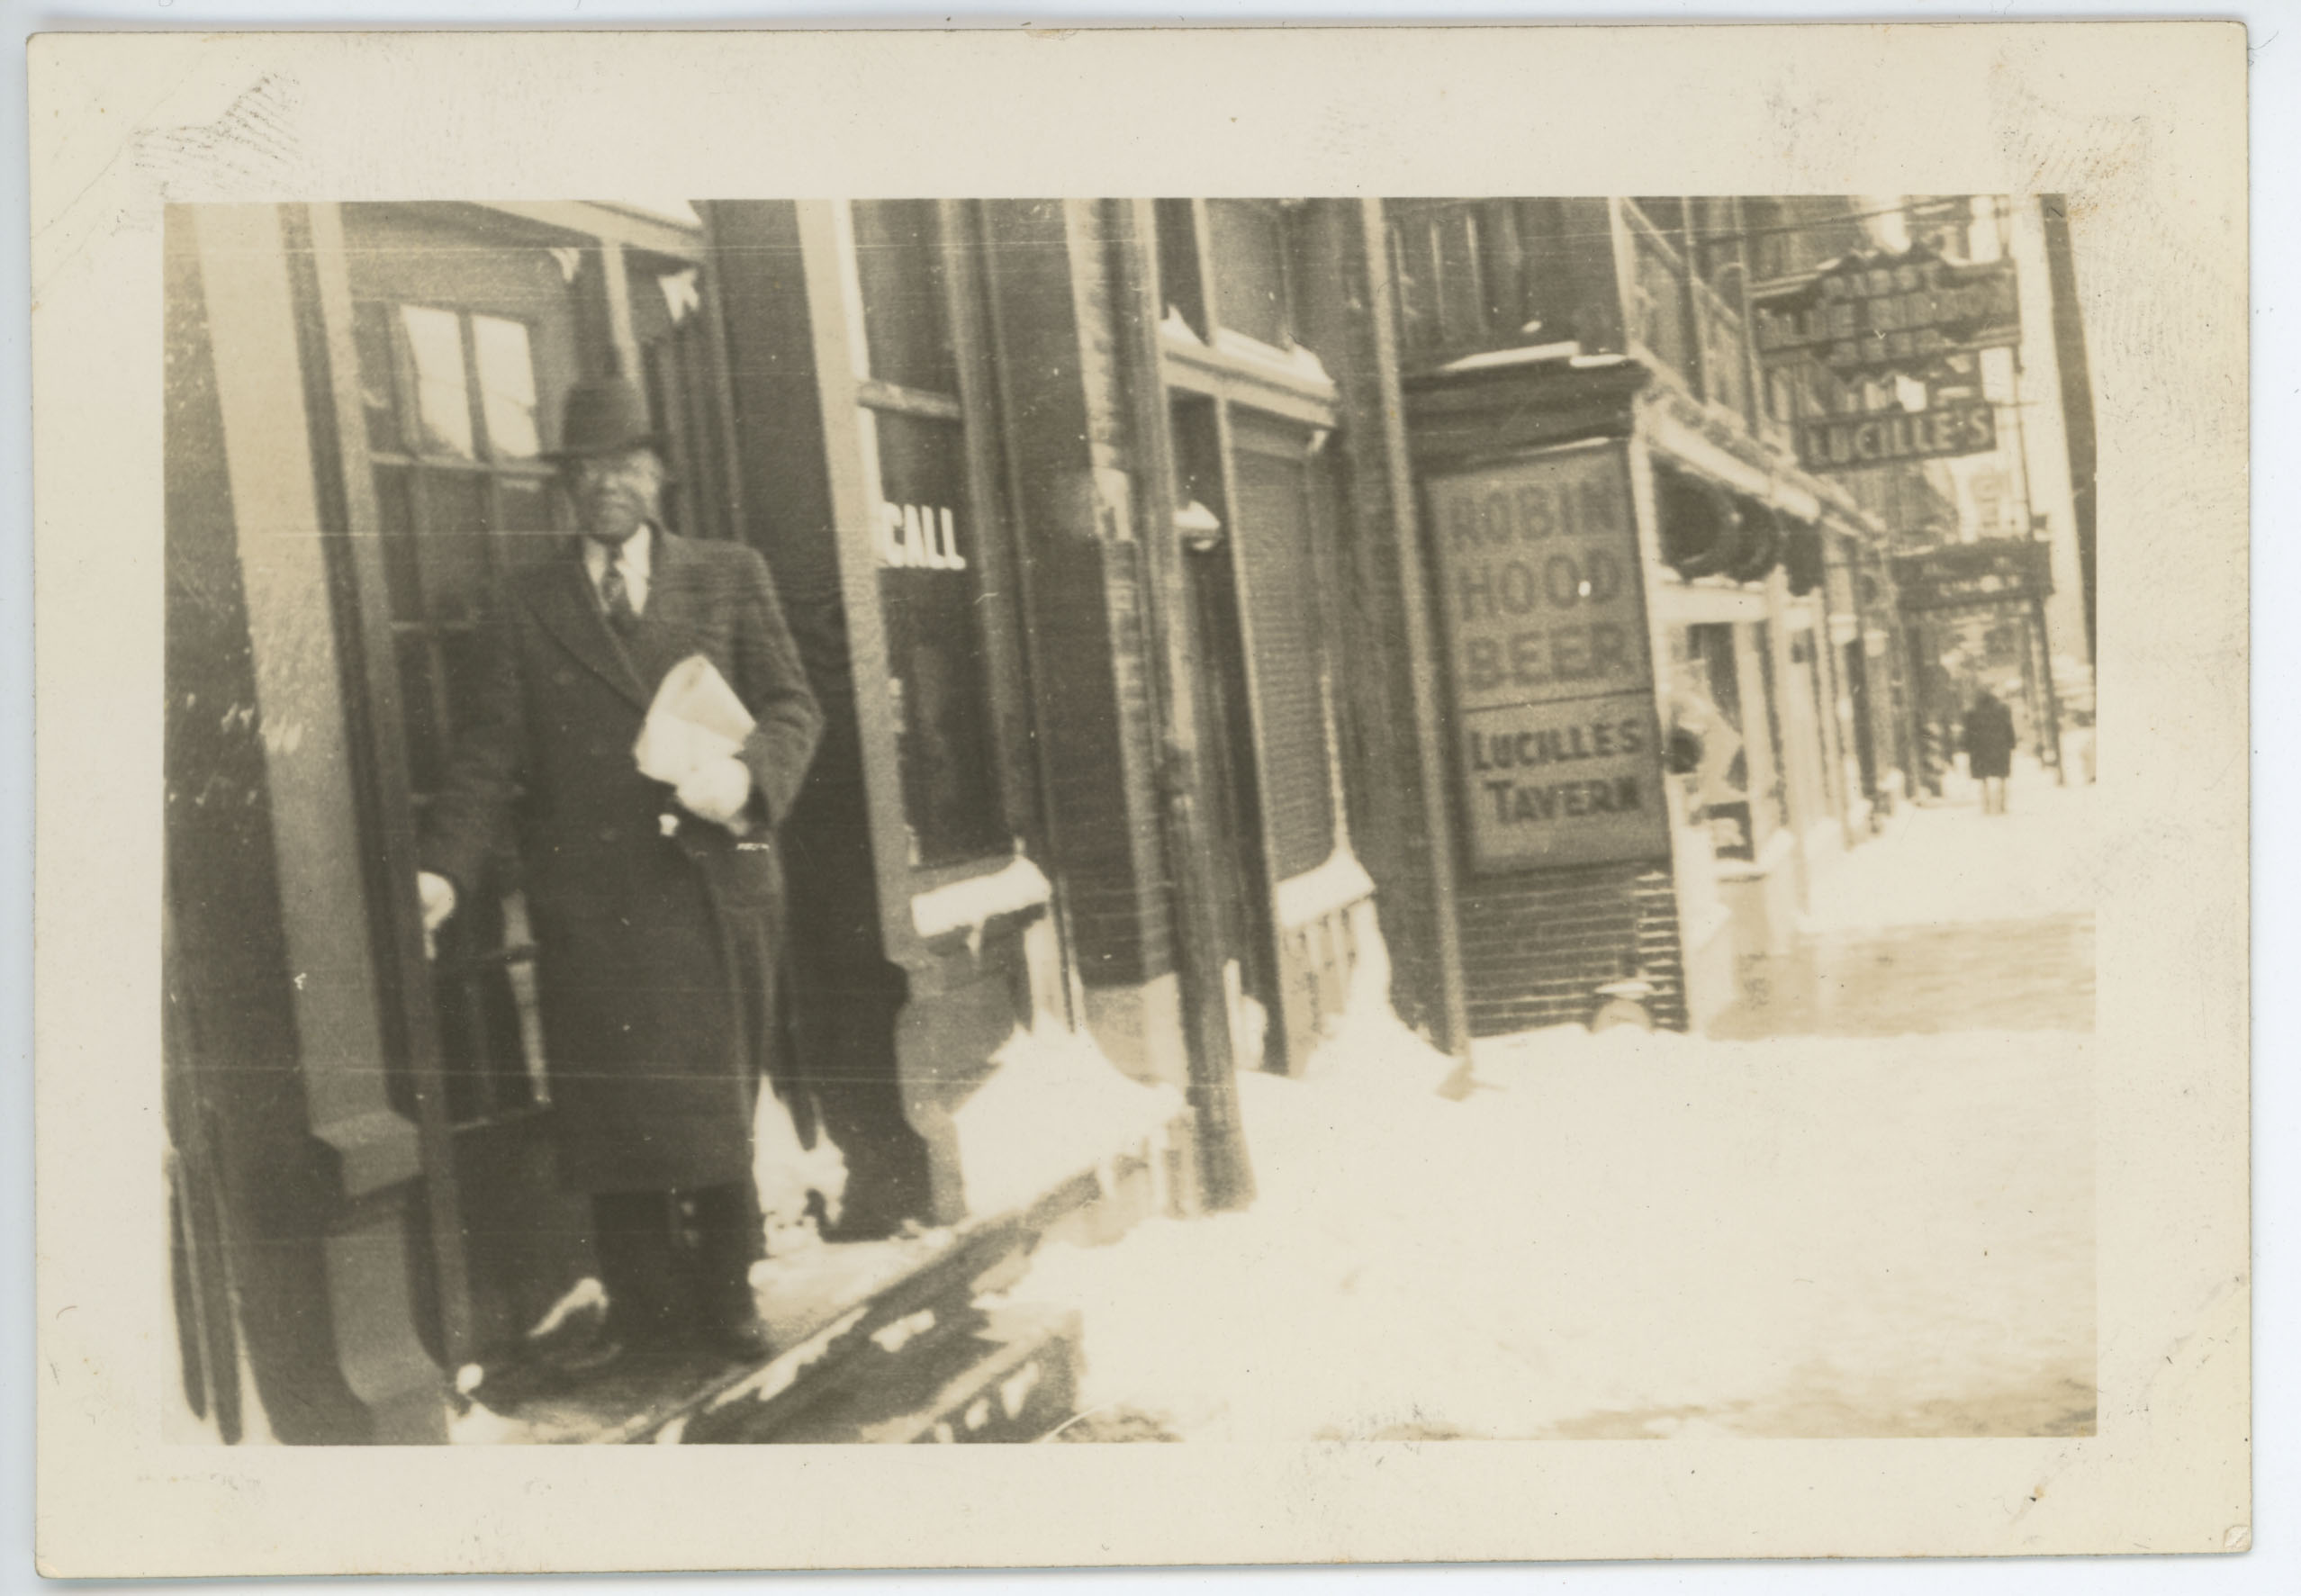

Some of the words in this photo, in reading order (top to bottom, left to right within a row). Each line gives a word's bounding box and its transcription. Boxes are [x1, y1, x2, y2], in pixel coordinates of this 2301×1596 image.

[880, 500, 967, 571] CALL
[1450, 476, 1618, 550] ROBIN
[1457, 547, 1621, 622] HOOD
[1466, 621, 1632, 691] BEER
[1469, 718, 1644, 772] LUCILLES
[1484, 775, 1643, 825] TAVERN
